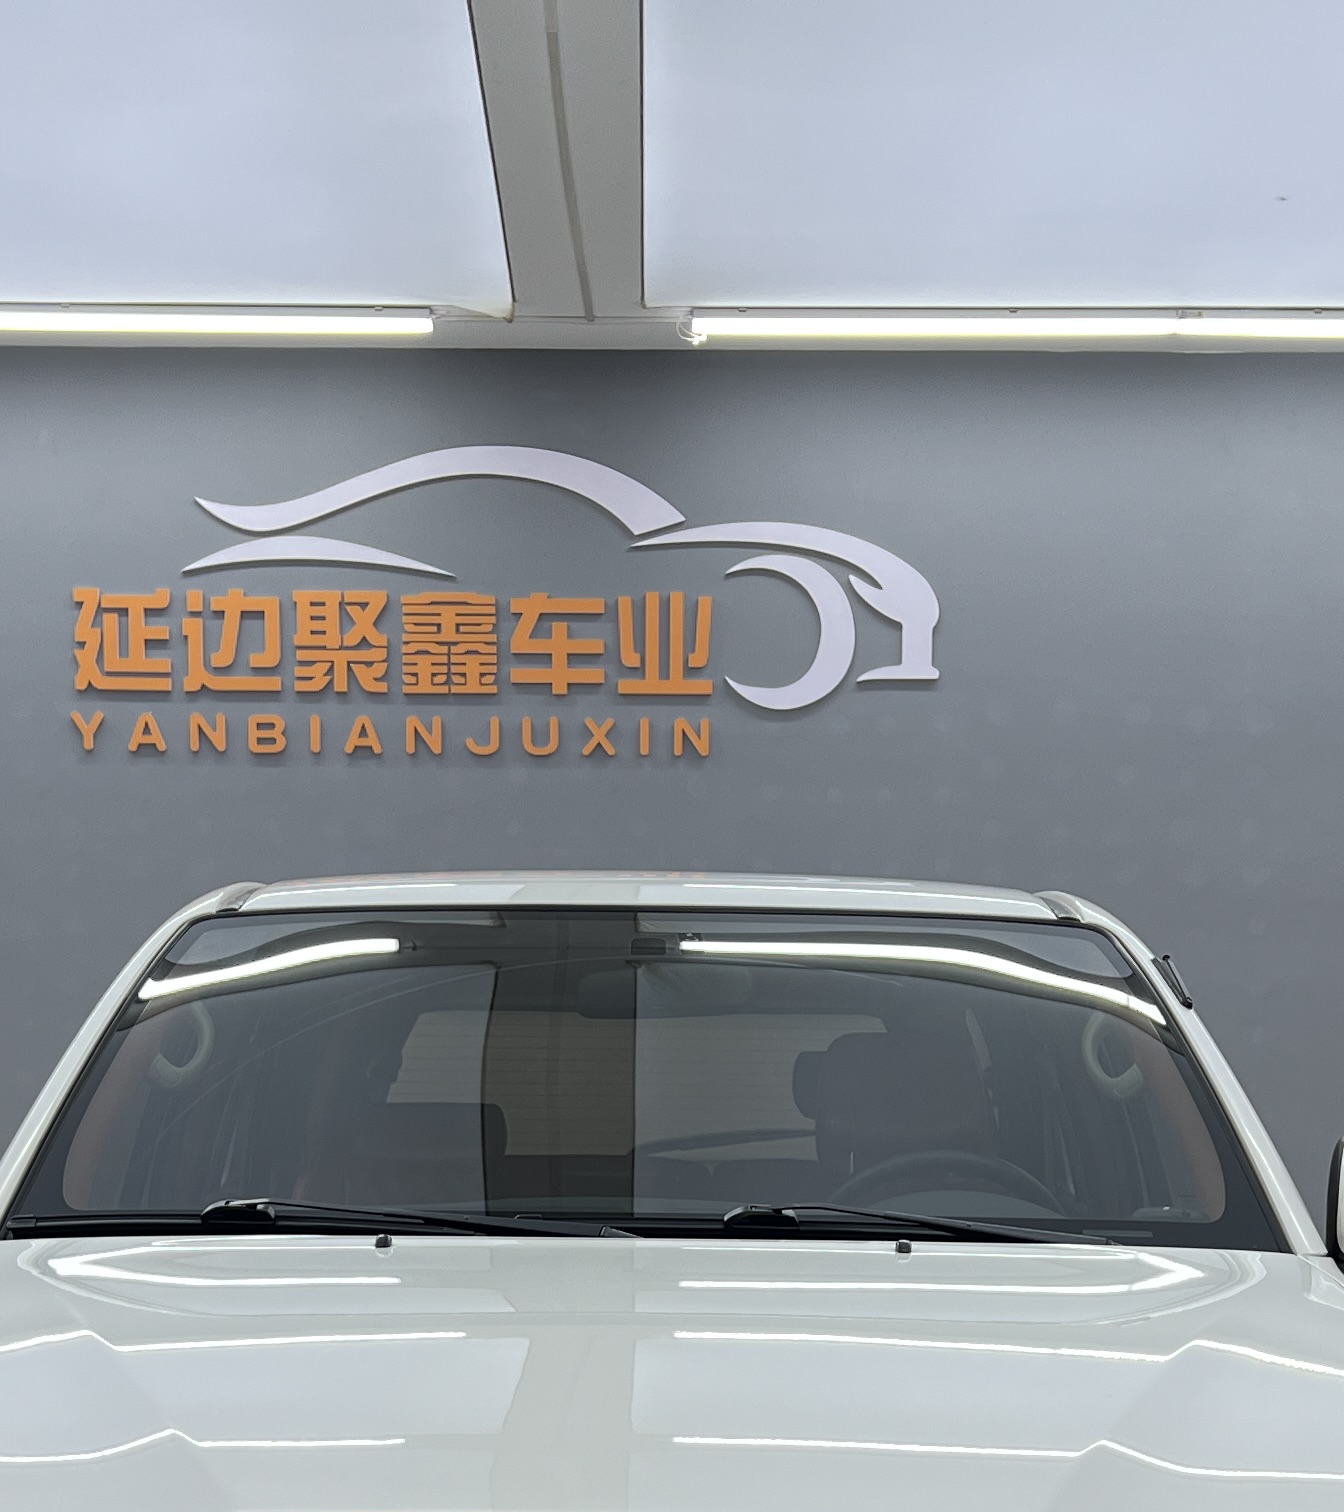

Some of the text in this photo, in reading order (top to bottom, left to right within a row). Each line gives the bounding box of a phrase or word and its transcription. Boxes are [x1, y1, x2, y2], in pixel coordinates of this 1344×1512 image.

[72, 586, 714, 696] 延边聚鑫车业
[69, 711, 712, 757] YANBIANJUXIN
